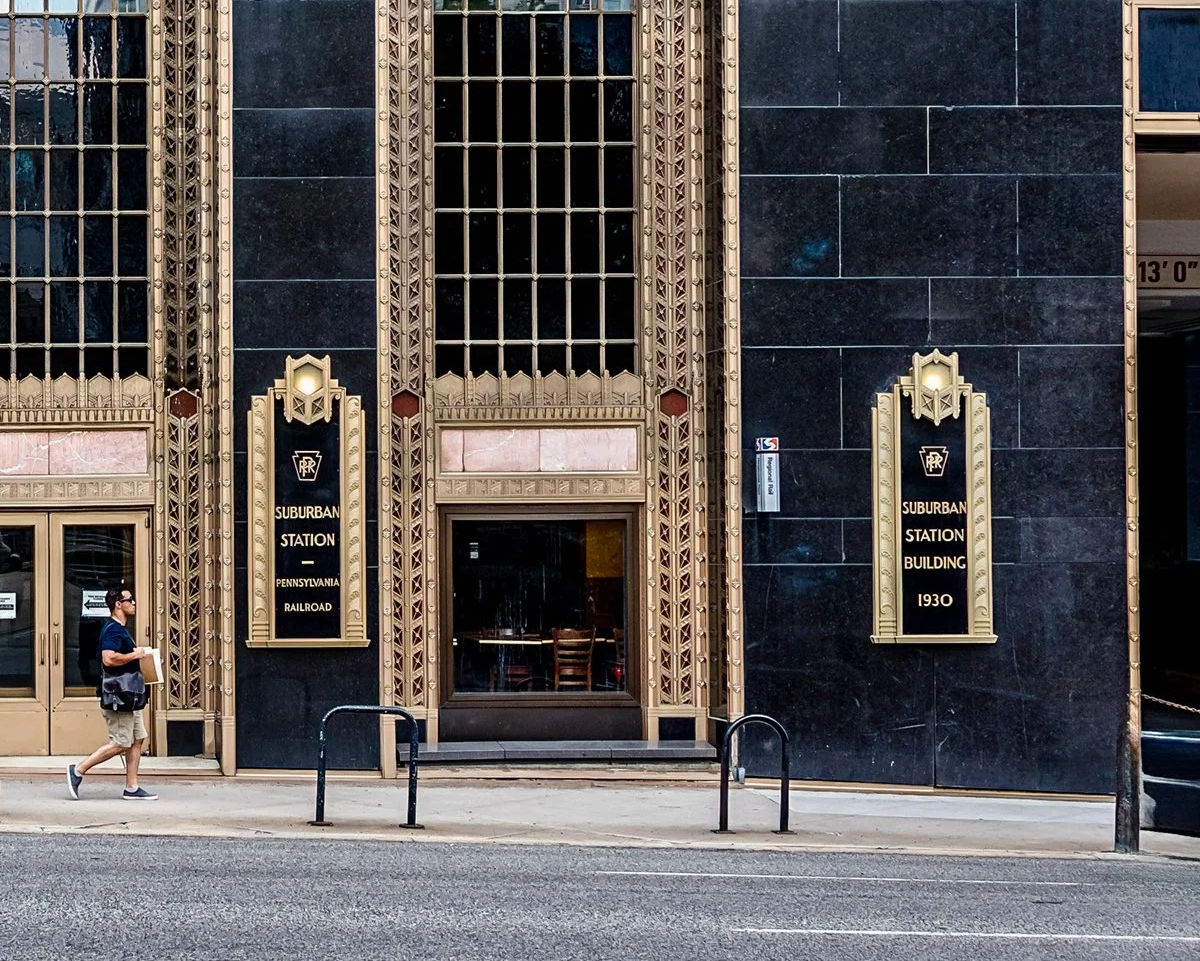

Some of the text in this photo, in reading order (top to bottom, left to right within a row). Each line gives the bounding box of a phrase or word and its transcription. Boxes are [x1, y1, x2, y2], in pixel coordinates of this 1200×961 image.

[275, 505, 340, 520] SUBURBAN
[902, 500, 968, 516] SUBURBAN
[280, 532, 336, 547] STATION
[905, 528, 965, 543] STATION
[903, 555, 967, 570] BUILDING
[275, 577, 340, 588] PENNSYLVANIA
[284, 601, 333, 613] RAILROAD
[917, 593, 954, 608] 1930
